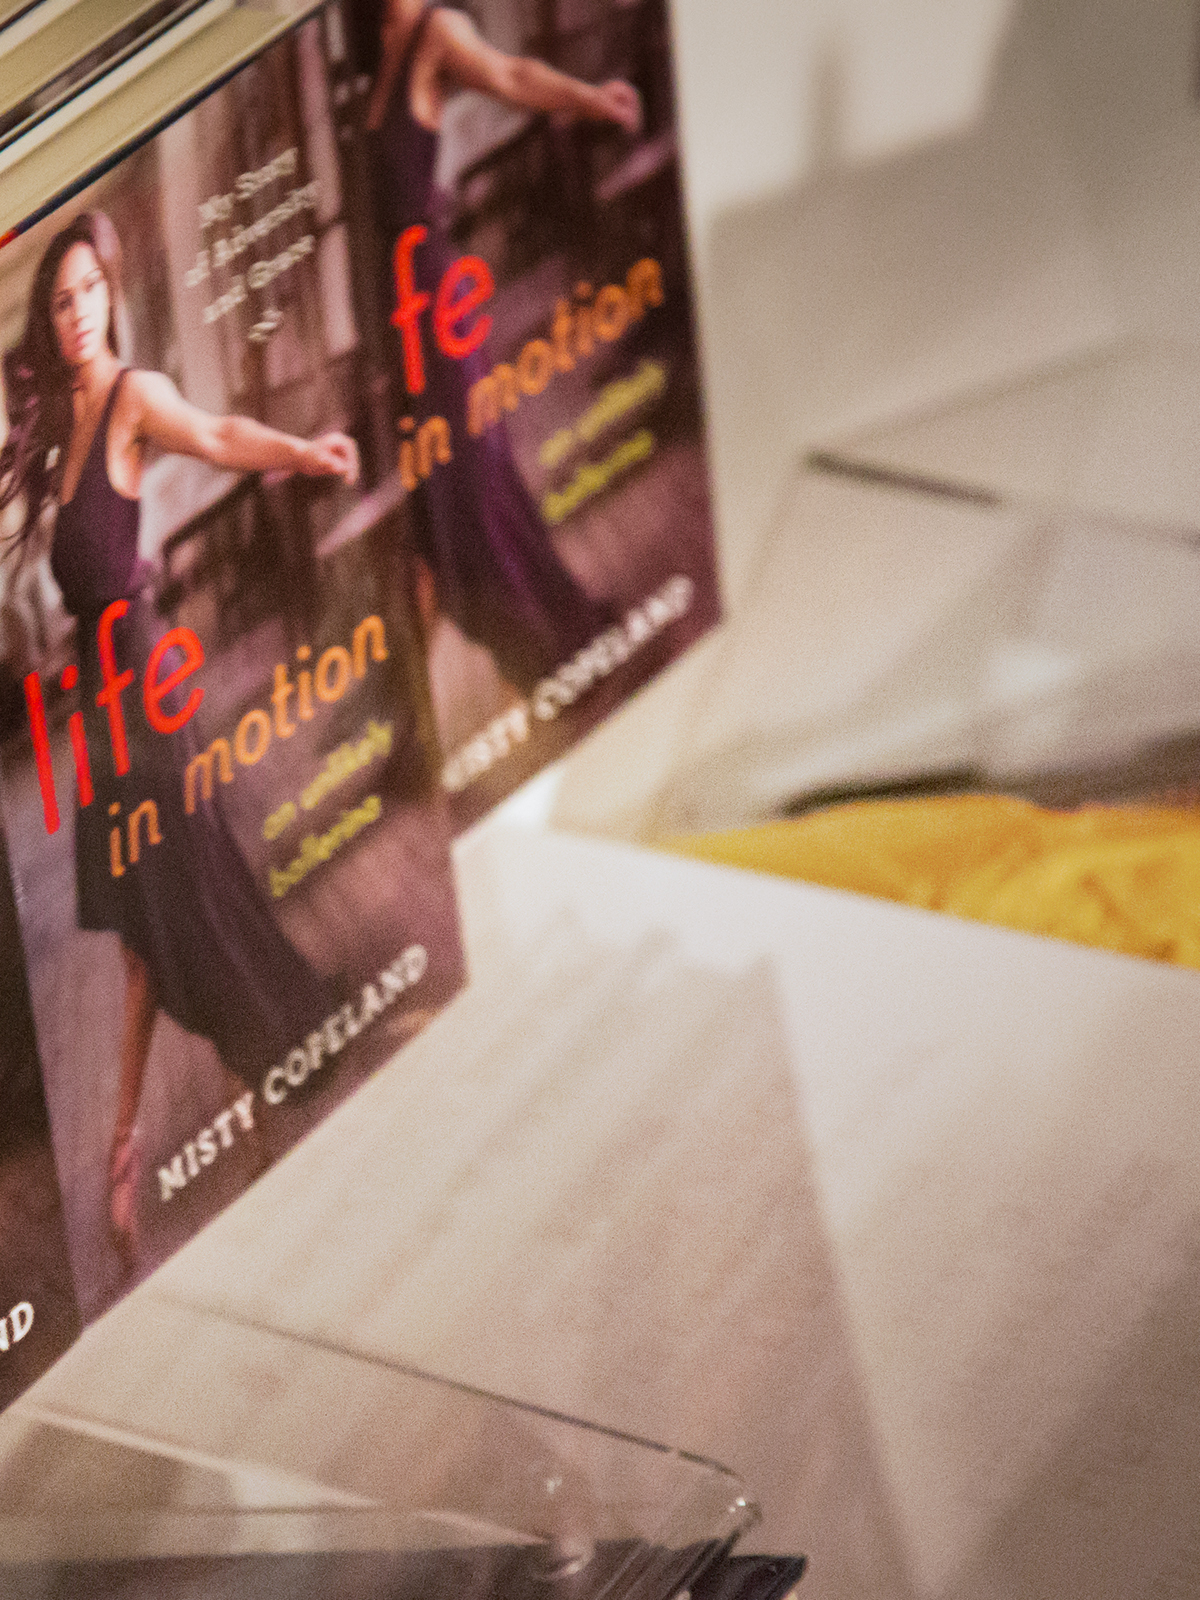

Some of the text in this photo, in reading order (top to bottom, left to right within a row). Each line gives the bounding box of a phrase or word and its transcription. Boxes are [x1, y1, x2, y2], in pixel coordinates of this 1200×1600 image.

[390, 225, 495, 395] fe
[400, 416, 451, 491] in
[467, 257, 663, 439] motion
[24, 600, 205, 834] life
[108, 614, 389, 877] in motion
[158, 944, 428, 1201] MISTY COPELAND
